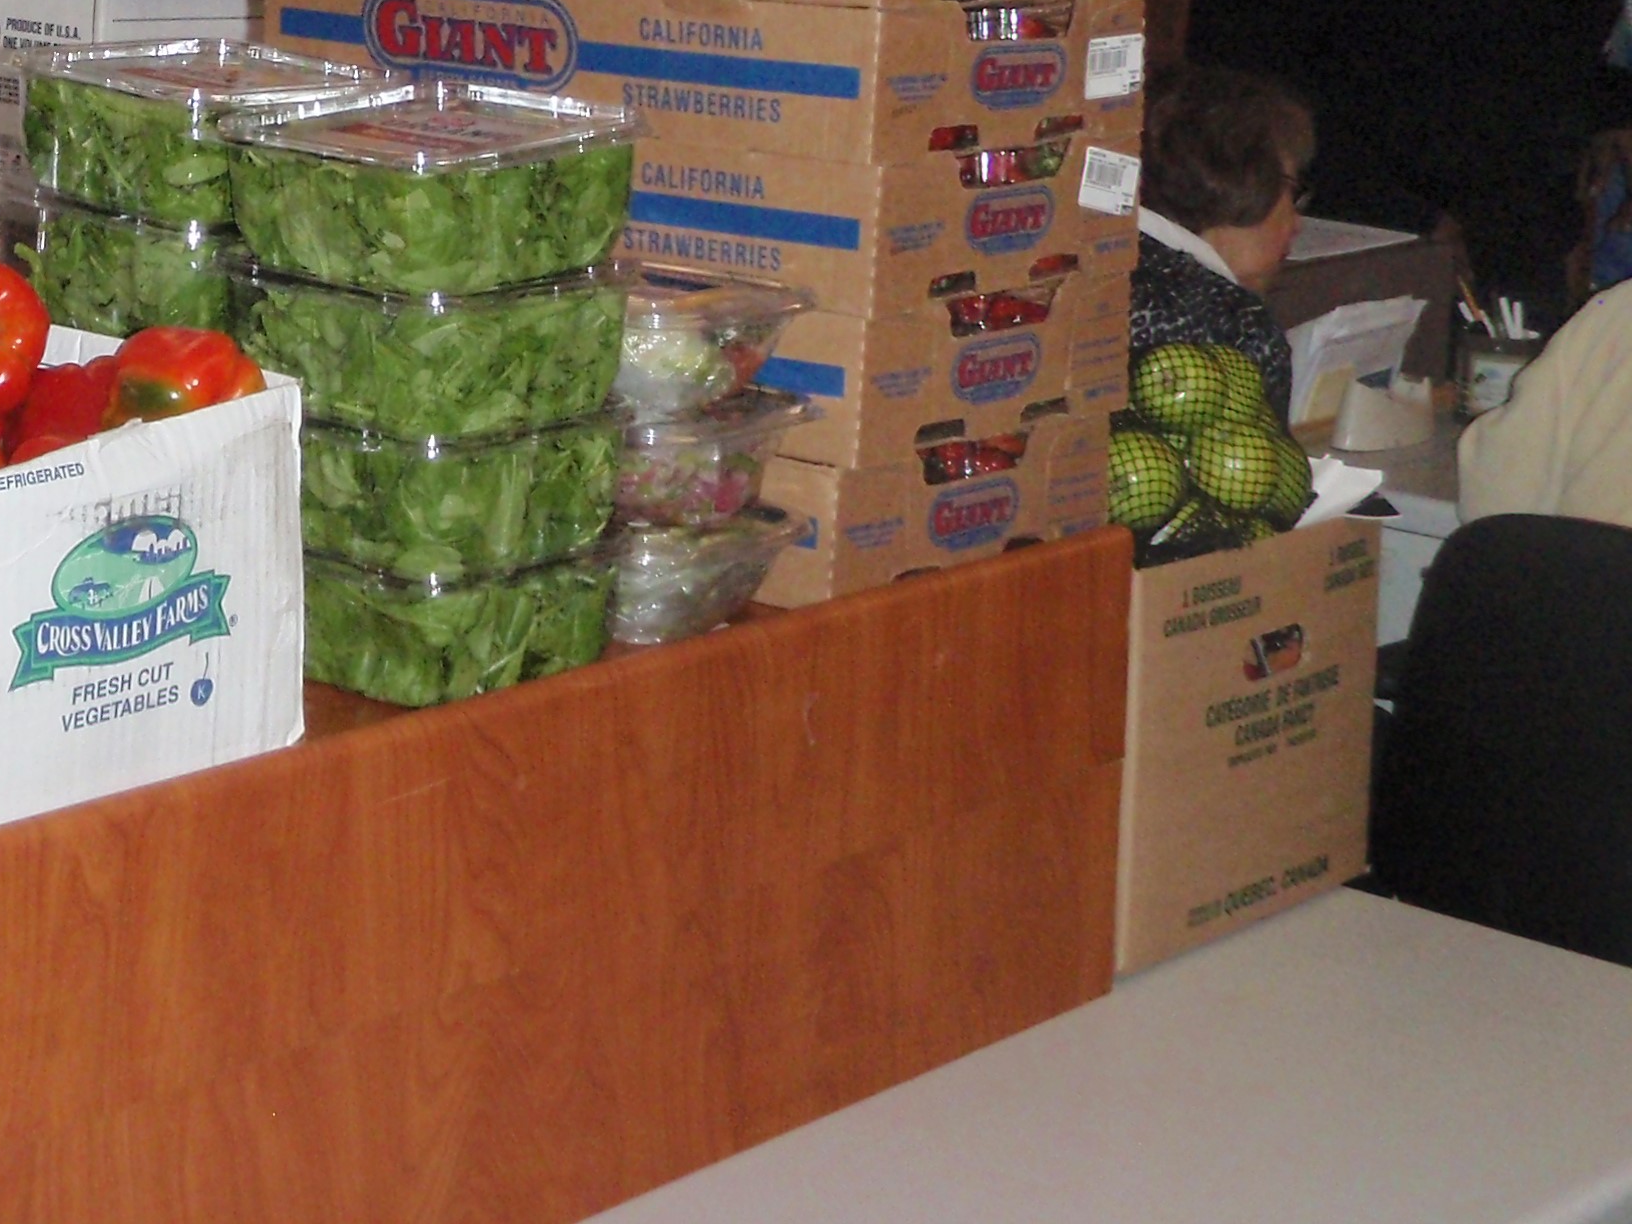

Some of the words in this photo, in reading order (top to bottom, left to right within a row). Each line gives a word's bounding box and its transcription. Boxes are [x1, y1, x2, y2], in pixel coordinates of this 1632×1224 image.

[6, 17, 42, 35] PRODUCE
[44, 22, 55, 37] OF
[56, 24, 81, 40] U.S.A.
[639, 17, 764, 51] CALIFORNIA
[975, 57, 1057, 91] GIANT
[622, 82, 782, 123] STRAWBERRIES
[641, 162, 765, 200] CALIFORNIA
[970, 203, 1046, 238] GIANT
[623, 227, 782, 271] STRAWBERRIES
[957, 350, 1033, 389] GIANT
[934, 495, 1012, 537] GIANT
[36, 621, 91, 656] CROSS
[93, 614, 152, 652] VALLEY
[154, 583, 209, 636] FARMS
[71, 672, 132, 705] FRESH
[137, 661, 175, 687] CUT
[61, 684, 179, 733] VEGETABLES
